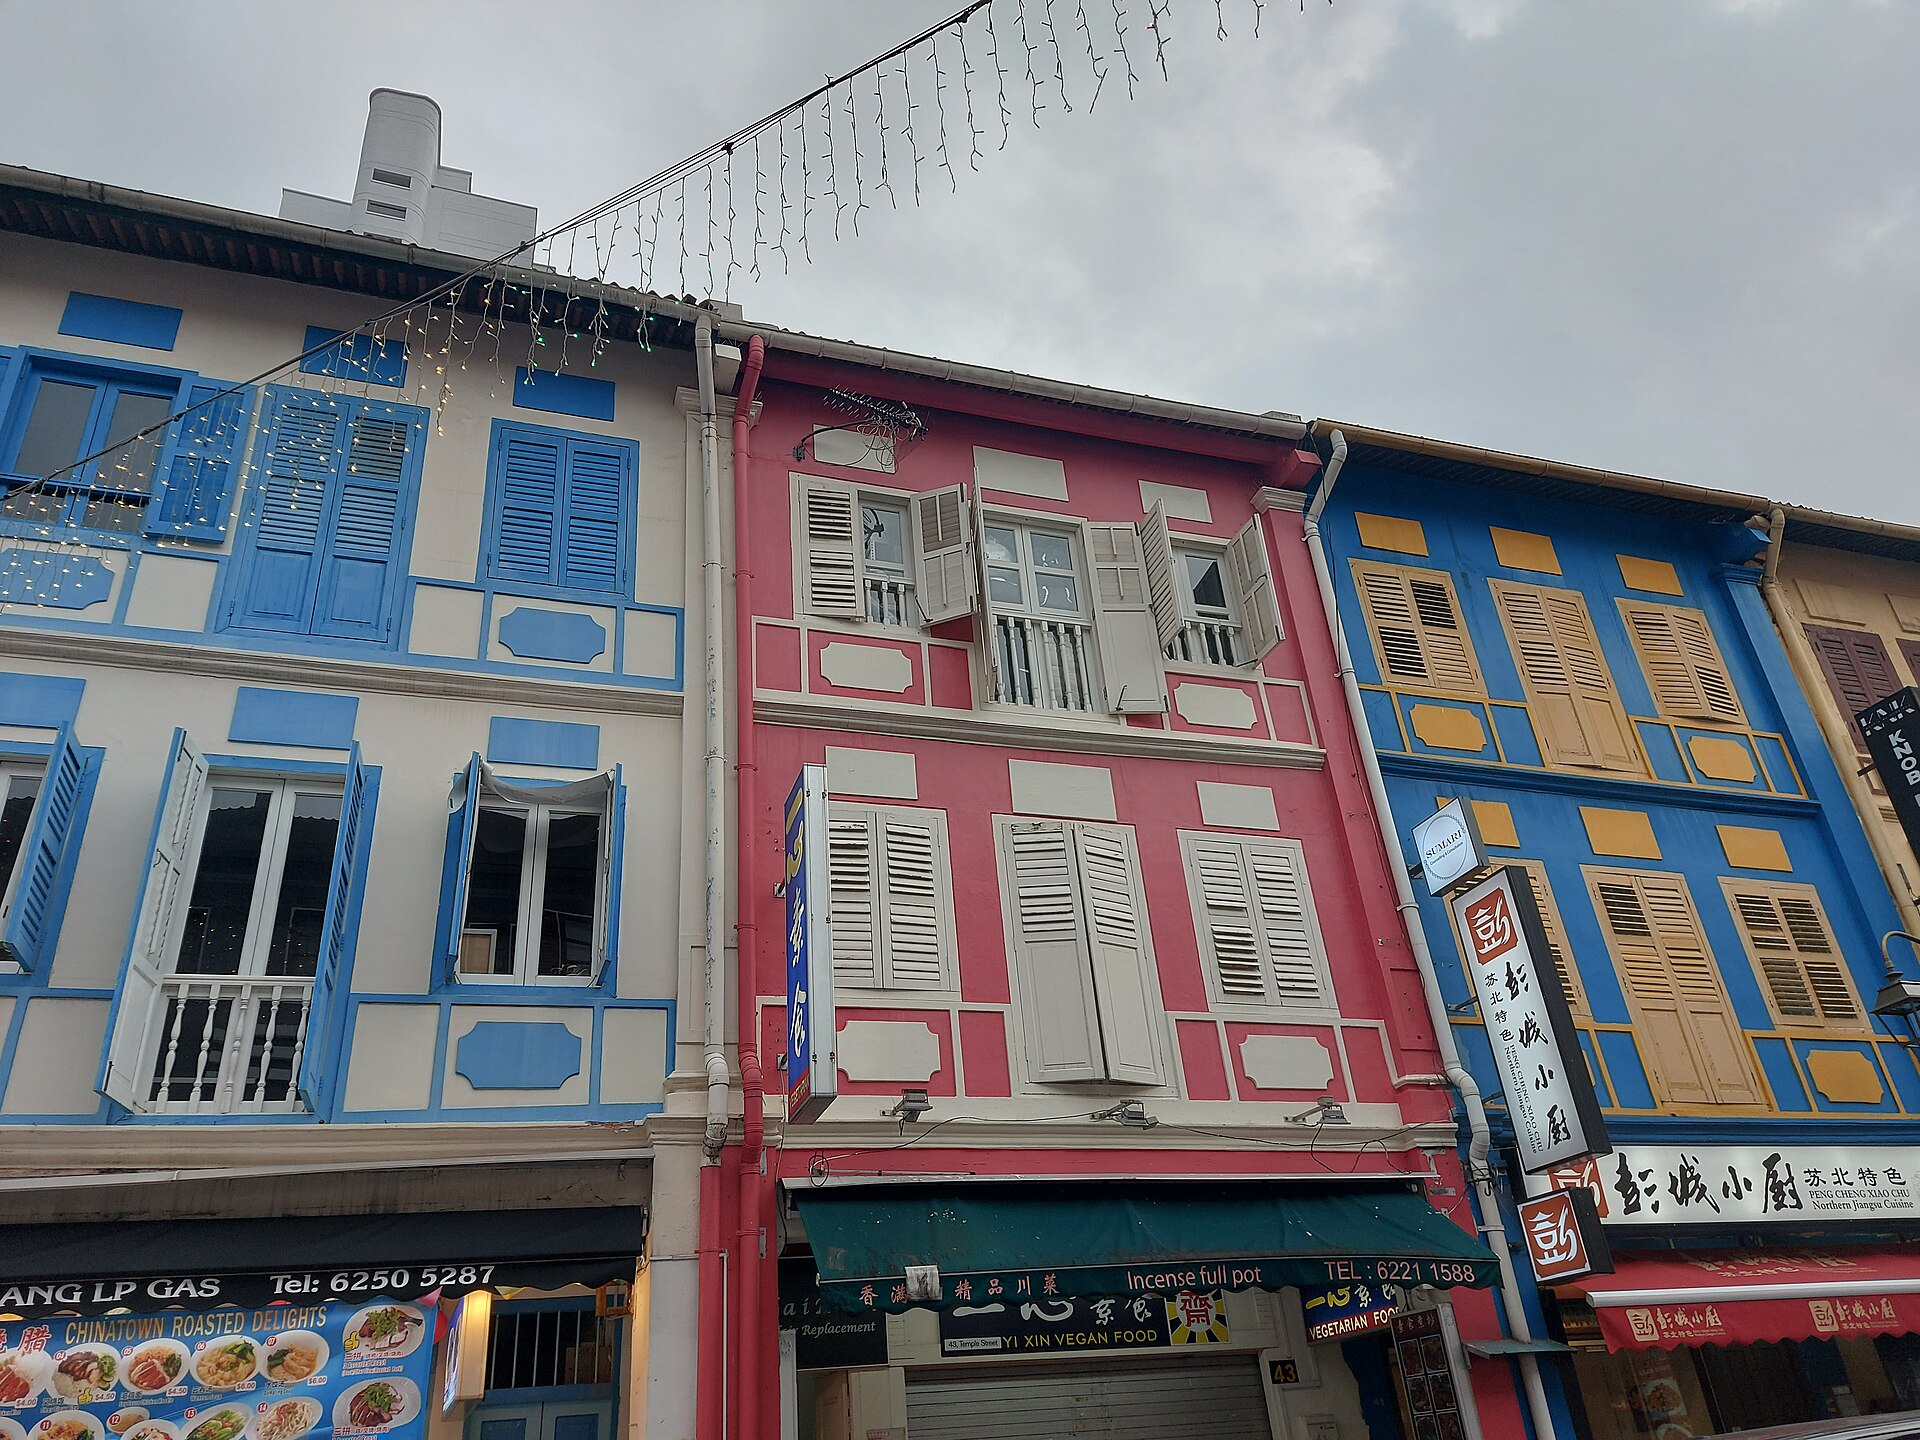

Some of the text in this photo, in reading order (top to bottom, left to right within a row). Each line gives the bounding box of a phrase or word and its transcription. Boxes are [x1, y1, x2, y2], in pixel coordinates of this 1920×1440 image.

[1426, 829, 1462, 859] SUMARI
[1485, 972, 1515, 1042] 苏北特色
[1504, 1046, 1537, 1154] Northern Jiangsu Cuisine
[1509, 1043, 1544, 1152] PENG CHENG XIAO CHU
[1803, 1167, 1907, 1187] 苏北特色
[1808, 1188, 1910, 1199] PENG CHENG XIAO CHU
[1812, 1198, 1914, 1212] Northern Jiangsu Cuisine
[270, 1265, 495, 1295] Tel: 6250 5287
[1127, 1264, 1262, 1290] Incense full pot
[1377, 1261, 1421, 1281] 6221
[1430, 1263, 1476, 1283] 1588
[0, 1278, 221, 1307] ANG LP GAS
[65, 1305, 327, 1345] CHINATOWN ROASTED DELIGHTS
[802, 1321, 877, 1339] Replacement
[1309, 1314, 1369, 1340] VEGETARIAN
[948, 1338, 999, 1350] 43, Temple Street
[1002, 1329, 1158, 1348] YI XIN VEGAN FOOD
[308, 1376, 327, 1385] $6.00
[1273, 1364, 1296, 1384] 43
[167, 1388, 187, 1396] $4.50
[236, 1382, 256, 1390] $6.00
[95, 1393, 115, 1401] $4.50
[111, 1415, 120, 1425] 12
[186, 1409, 196, 1418] 13
[41, 1421, 50, 1430] 11
